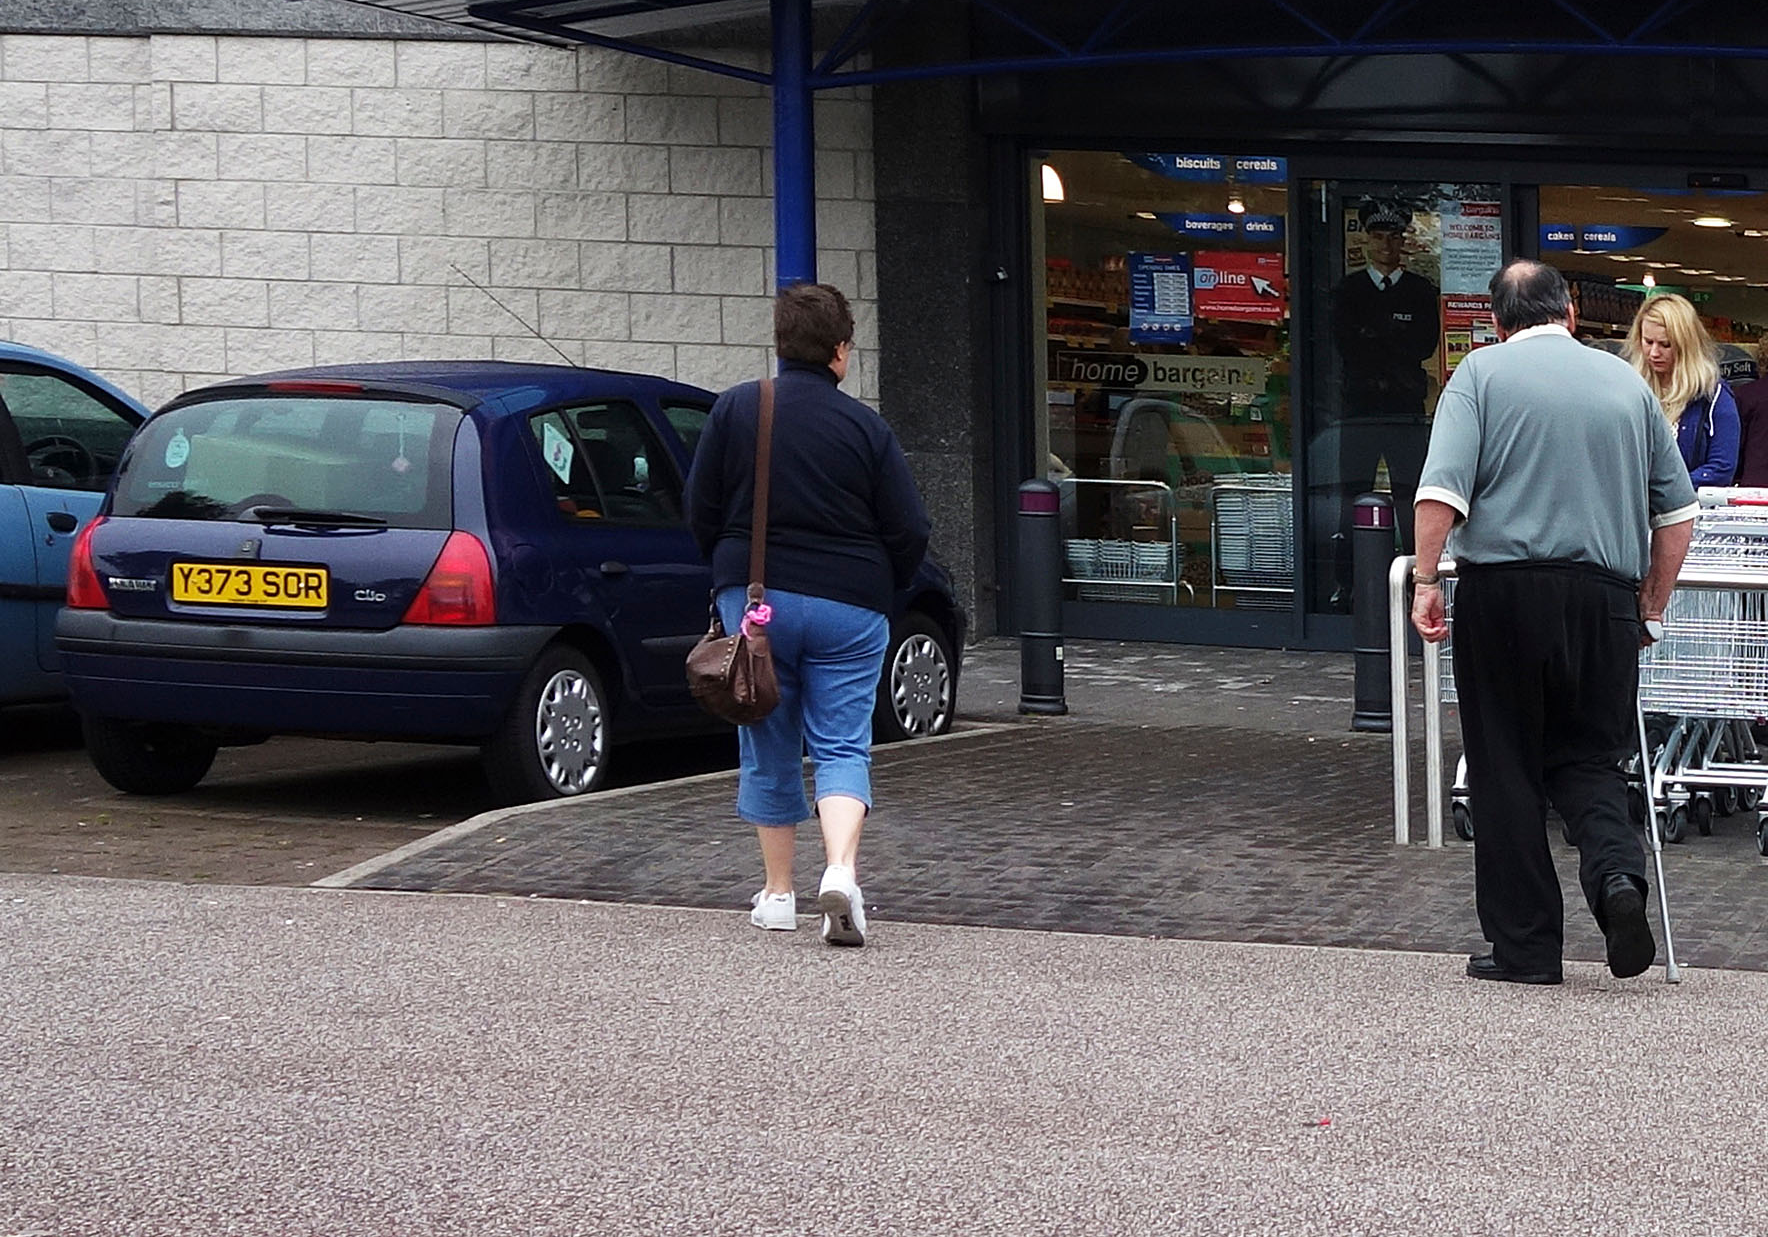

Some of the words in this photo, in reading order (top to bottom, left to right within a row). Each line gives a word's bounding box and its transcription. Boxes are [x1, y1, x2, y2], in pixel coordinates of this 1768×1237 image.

[1176, 157, 1221, 169] biscuits
[1236, 159, 1277, 170] cereals
[1185, 220, 1234, 230] beverages
[1246, 222, 1274, 231] drinks
[1547, 231, 1575, 241] cakes
[1583, 232, 1616, 242] cereals
[1200, 271, 1246, 285] online
[1072, 358, 1138, 381] home
[178, 566, 252, 597] Y373
[262, 571, 322, 600] SOR
[354, 589, 387, 602] Clio
